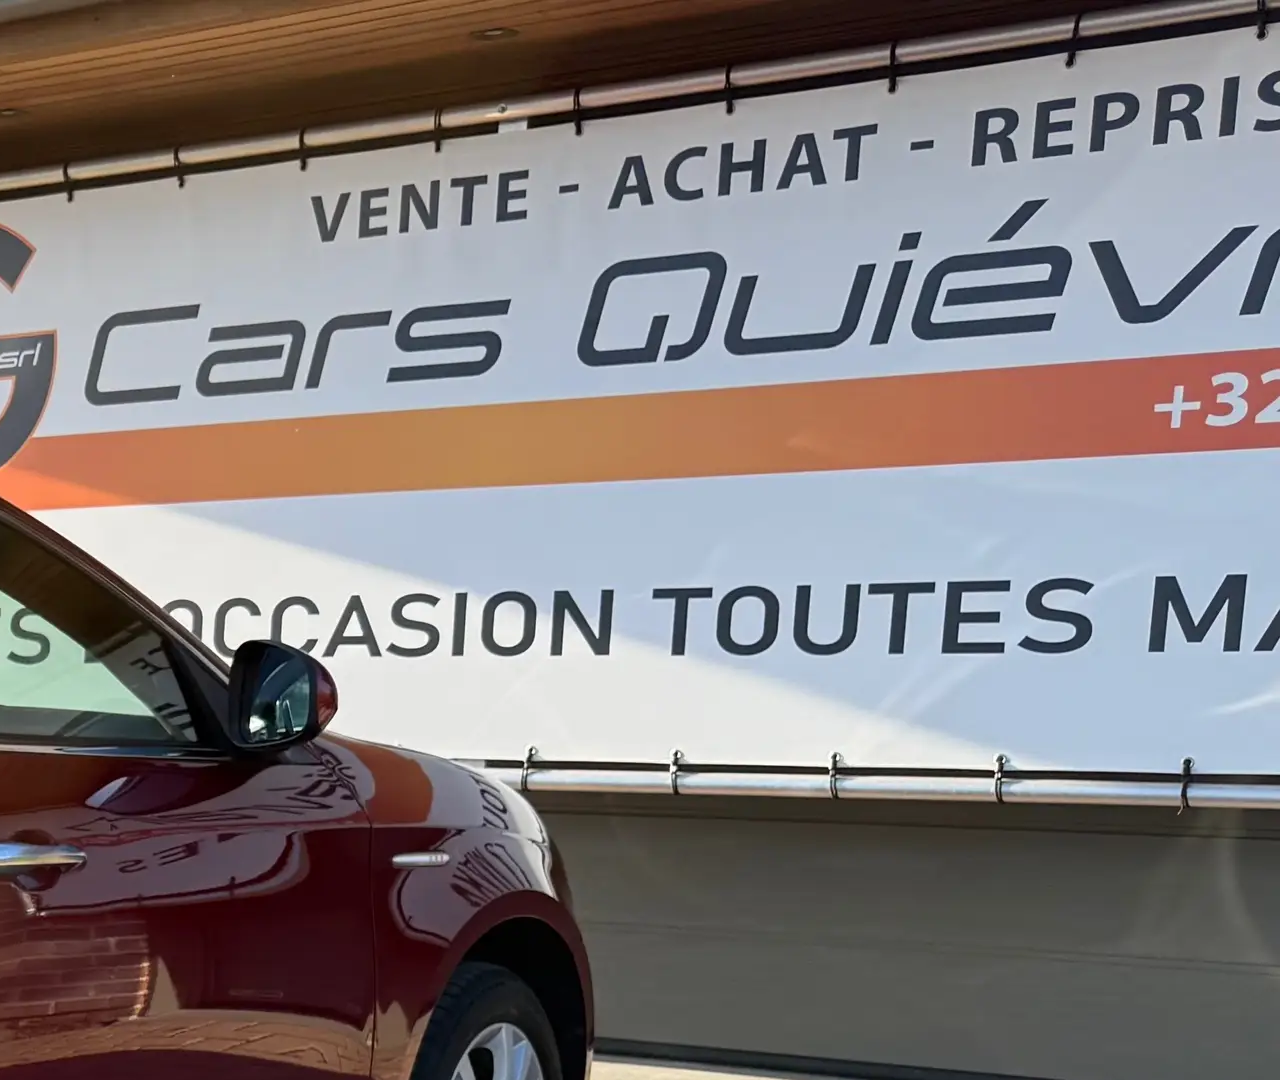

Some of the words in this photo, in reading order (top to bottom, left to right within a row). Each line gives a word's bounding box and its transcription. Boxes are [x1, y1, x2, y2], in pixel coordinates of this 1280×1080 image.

[311, 168, 530, 244] VENTE
[607, 123, 879, 210] ACHAT
[85, 298, 512, 406] Cars
[83, 589, 615, 662] OCCASION
[652, 577, 1096, 657] TOUTES
